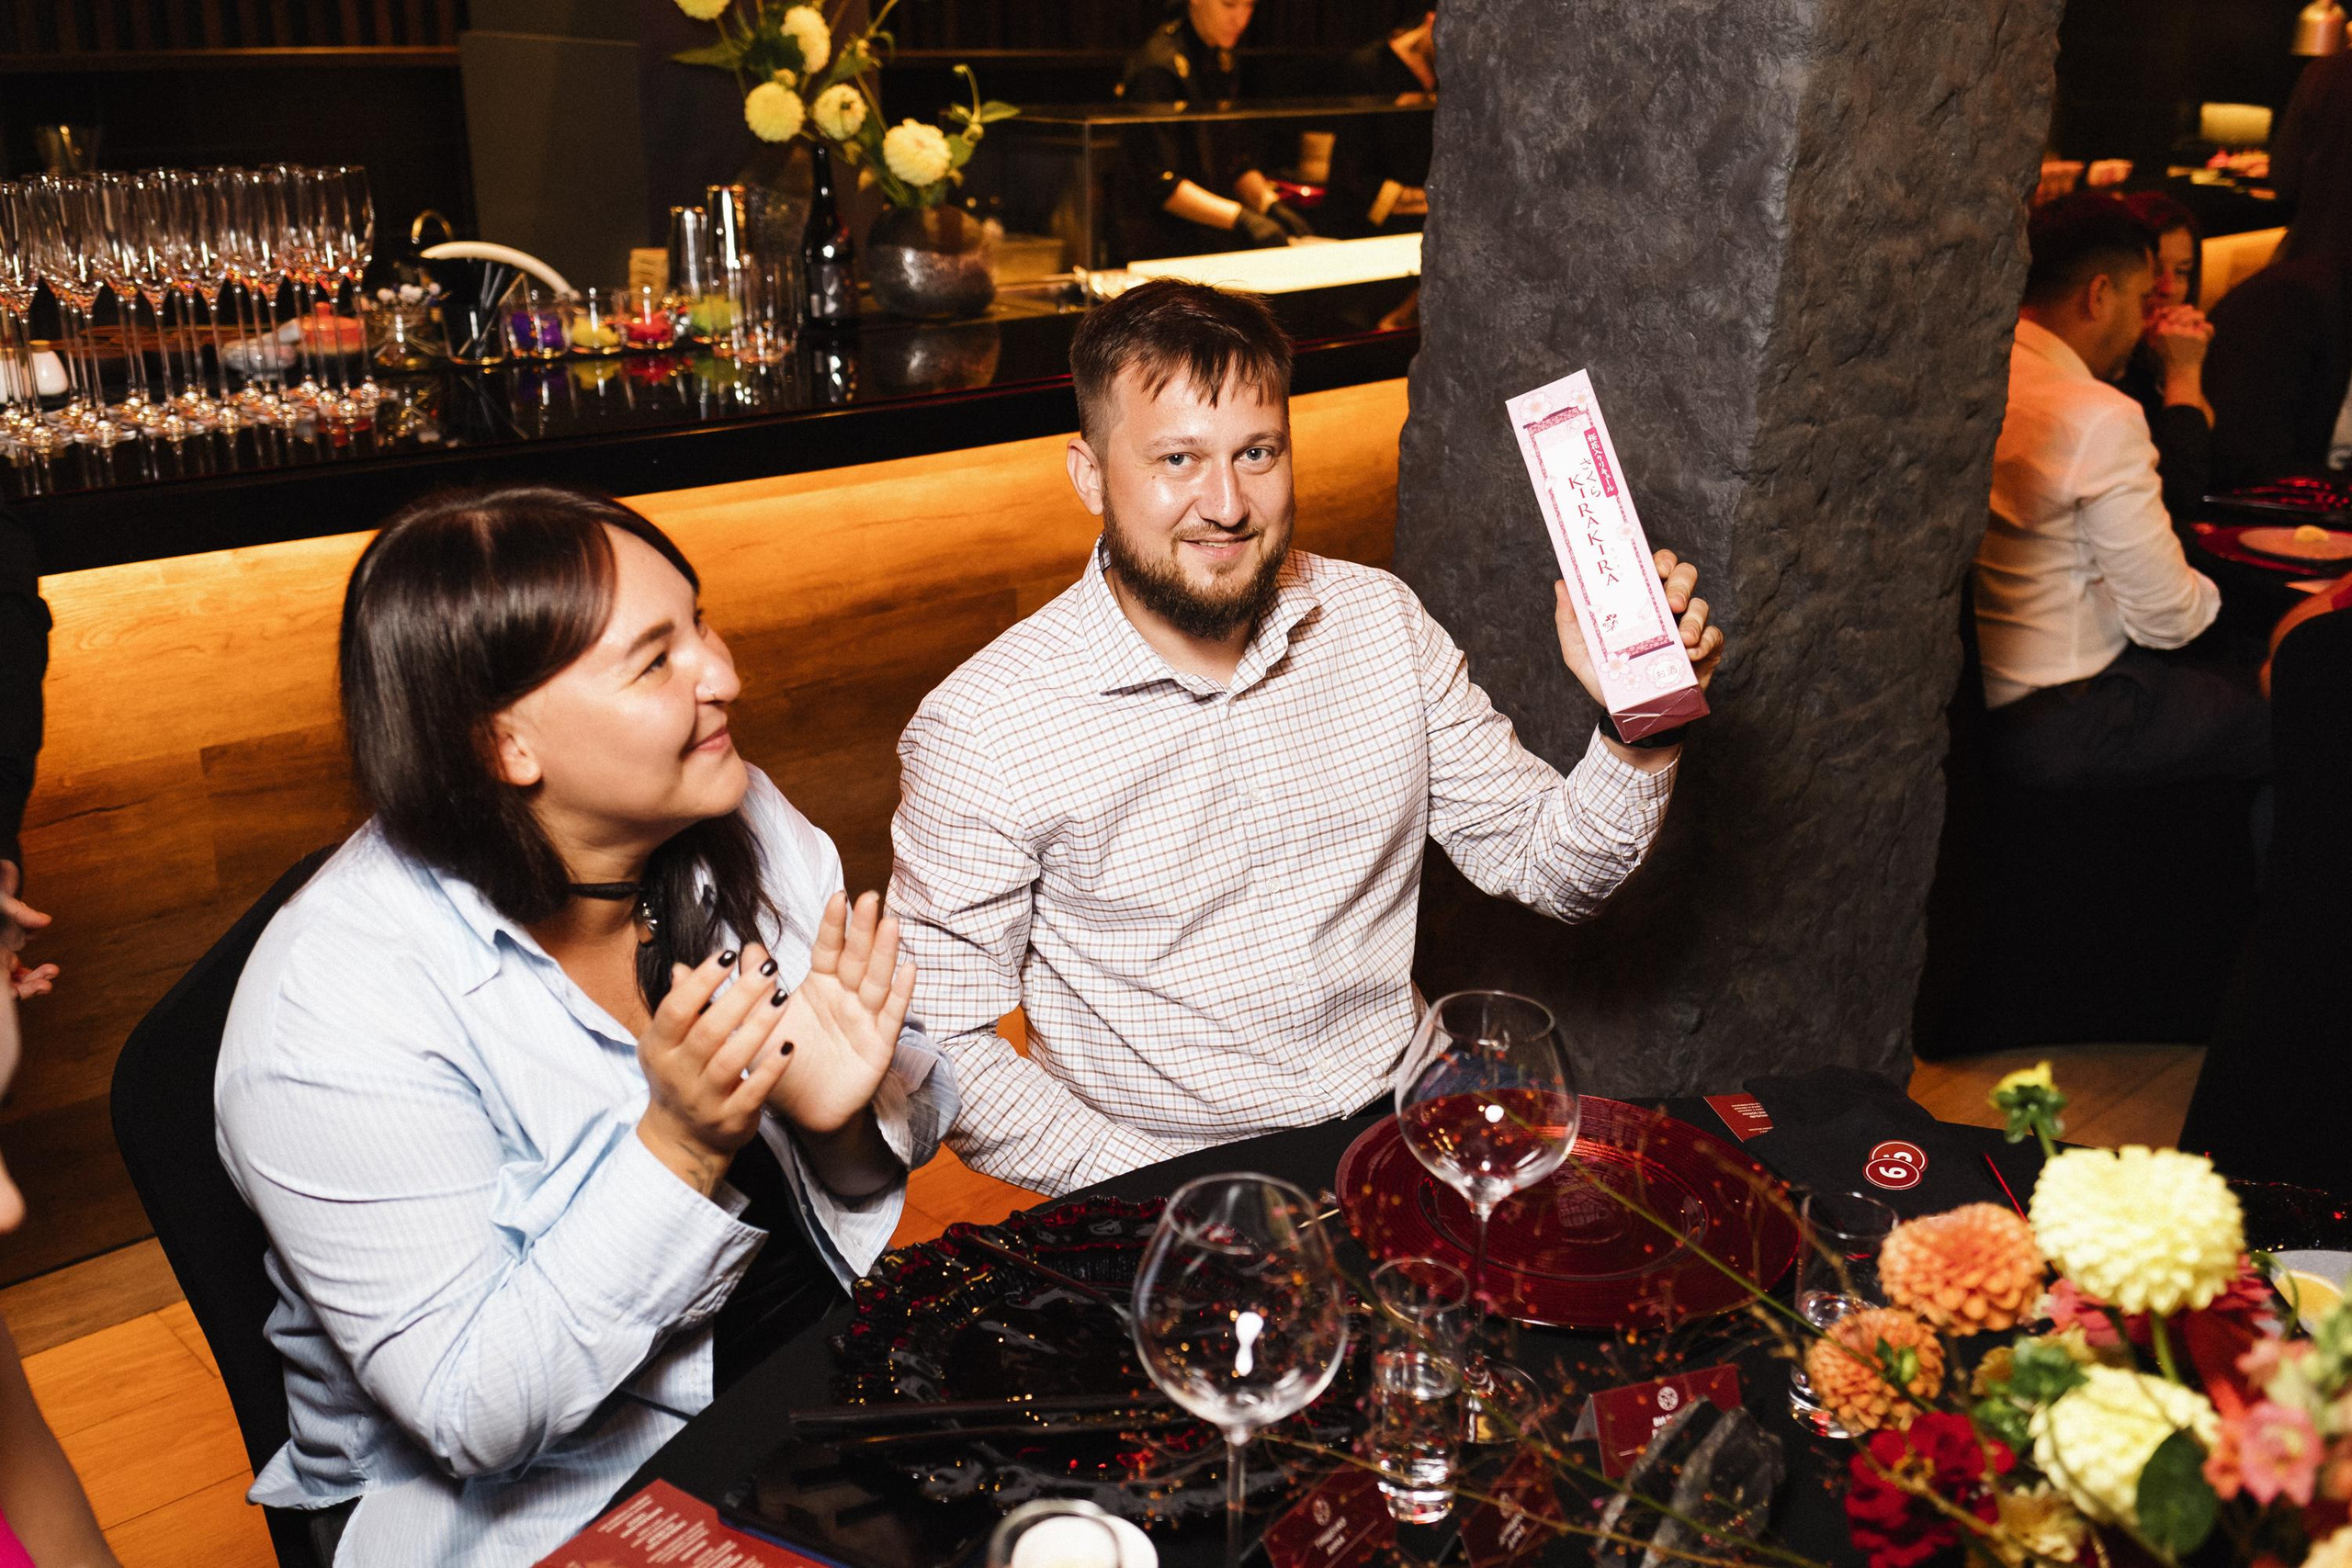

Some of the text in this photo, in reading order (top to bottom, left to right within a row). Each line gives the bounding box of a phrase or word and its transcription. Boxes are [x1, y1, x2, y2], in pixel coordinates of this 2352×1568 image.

[1579, 457, 1601, 498] さくら
[1567, 474, 1620, 587] KIRAKIRA
